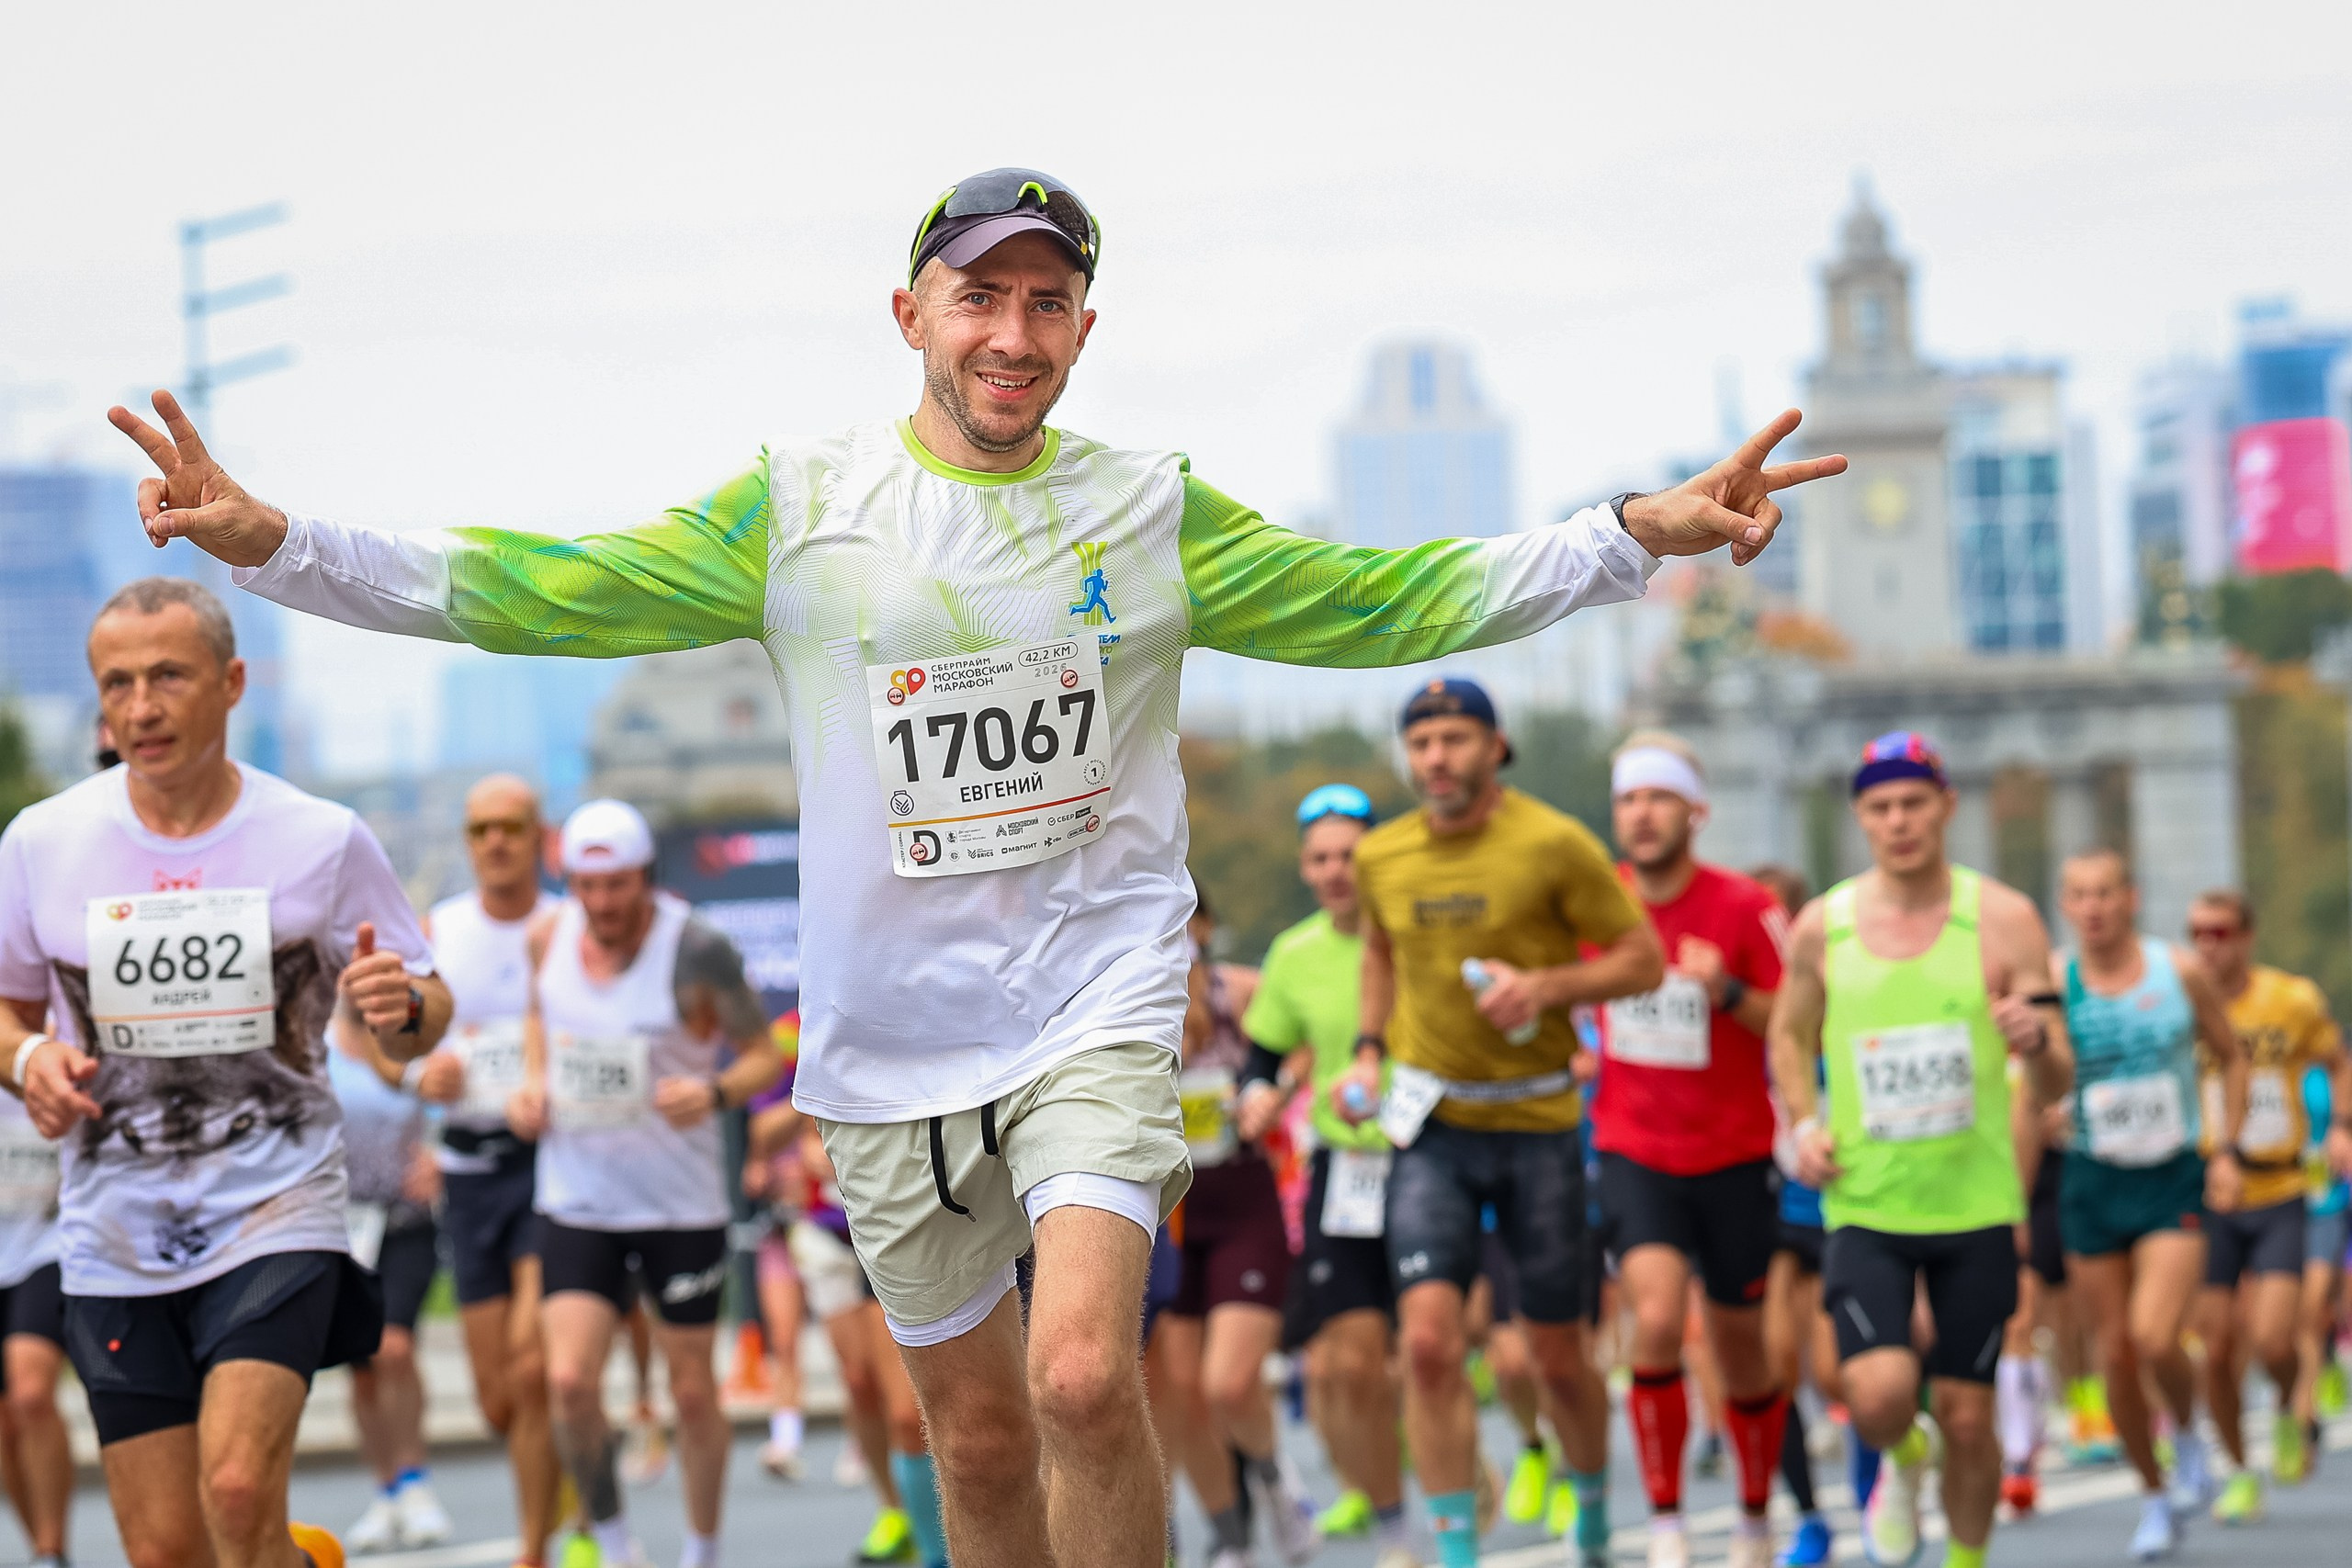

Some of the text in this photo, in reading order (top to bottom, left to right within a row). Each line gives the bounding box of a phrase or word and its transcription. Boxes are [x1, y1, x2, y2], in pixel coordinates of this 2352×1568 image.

[1024, 646, 1070, 663] 42,2 КМ
[931, 657, 991, 672] СБЕРПРАЙМ
[932, 662, 1013, 682] МОСКОВСКИЙ
[1035, 662, 1067, 678] 2026
[933, 677, 994, 694] МАРАФОН
[888, 688, 1096, 783] 17067
[1091, 767, 1097, 777] 1
[960, 772, 1044, 803] ЕВГЕНИЙ
[1007, 817, 1039, 828] МОСКОВСКИЙ
[1057, 813, 1075, 823] СБЕР
[1008, 828, 1024, 836] СПОРТ
[912, 829, 942, 866] D
[115, 933, 245, 986] 6682
[111, 1023, 134, 1050] D
